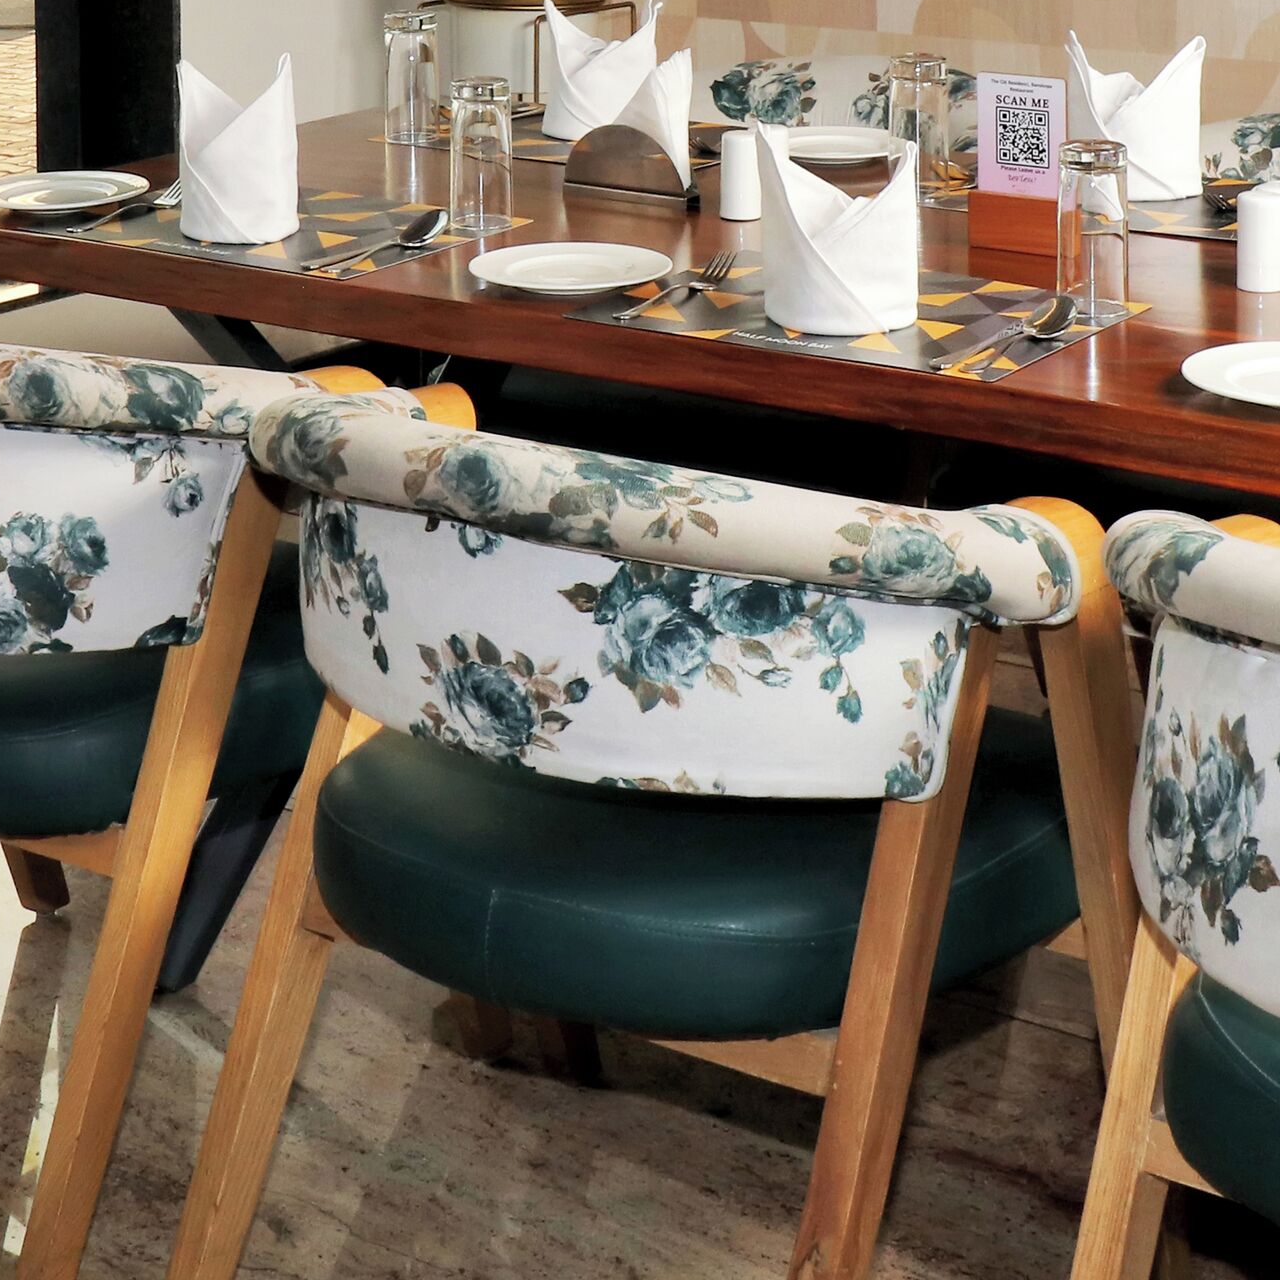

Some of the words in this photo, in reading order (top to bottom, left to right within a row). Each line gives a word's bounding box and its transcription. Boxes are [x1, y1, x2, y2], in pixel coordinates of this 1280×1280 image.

[995, 94, 1027, 107] SCAN
[1031, 97, 1050, 108] ME
[732, 331, 767, 340] HALF
